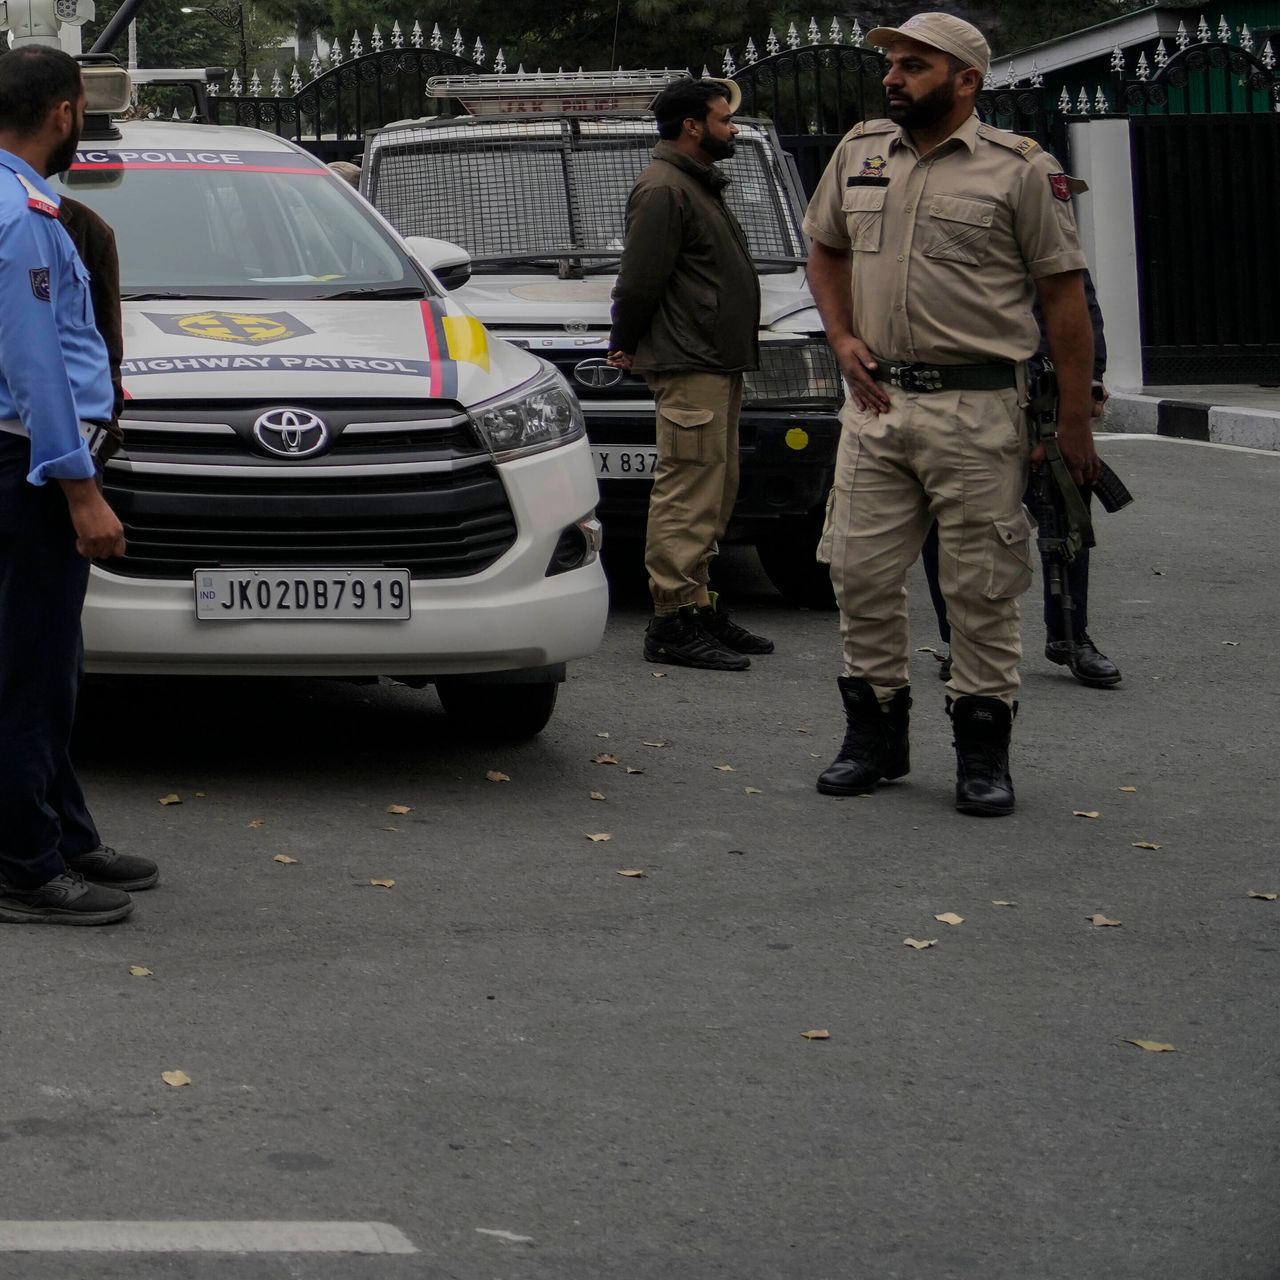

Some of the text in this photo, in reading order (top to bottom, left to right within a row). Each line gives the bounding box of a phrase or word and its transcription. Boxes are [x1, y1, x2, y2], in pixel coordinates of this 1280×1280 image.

[115, 152, 244, 165] POLICE
[119, 357, 419, 373] HIGHWAY PATROL
[199, 590, 216, 600] IND
[221, 579, 404, 609] JK02DB7919
